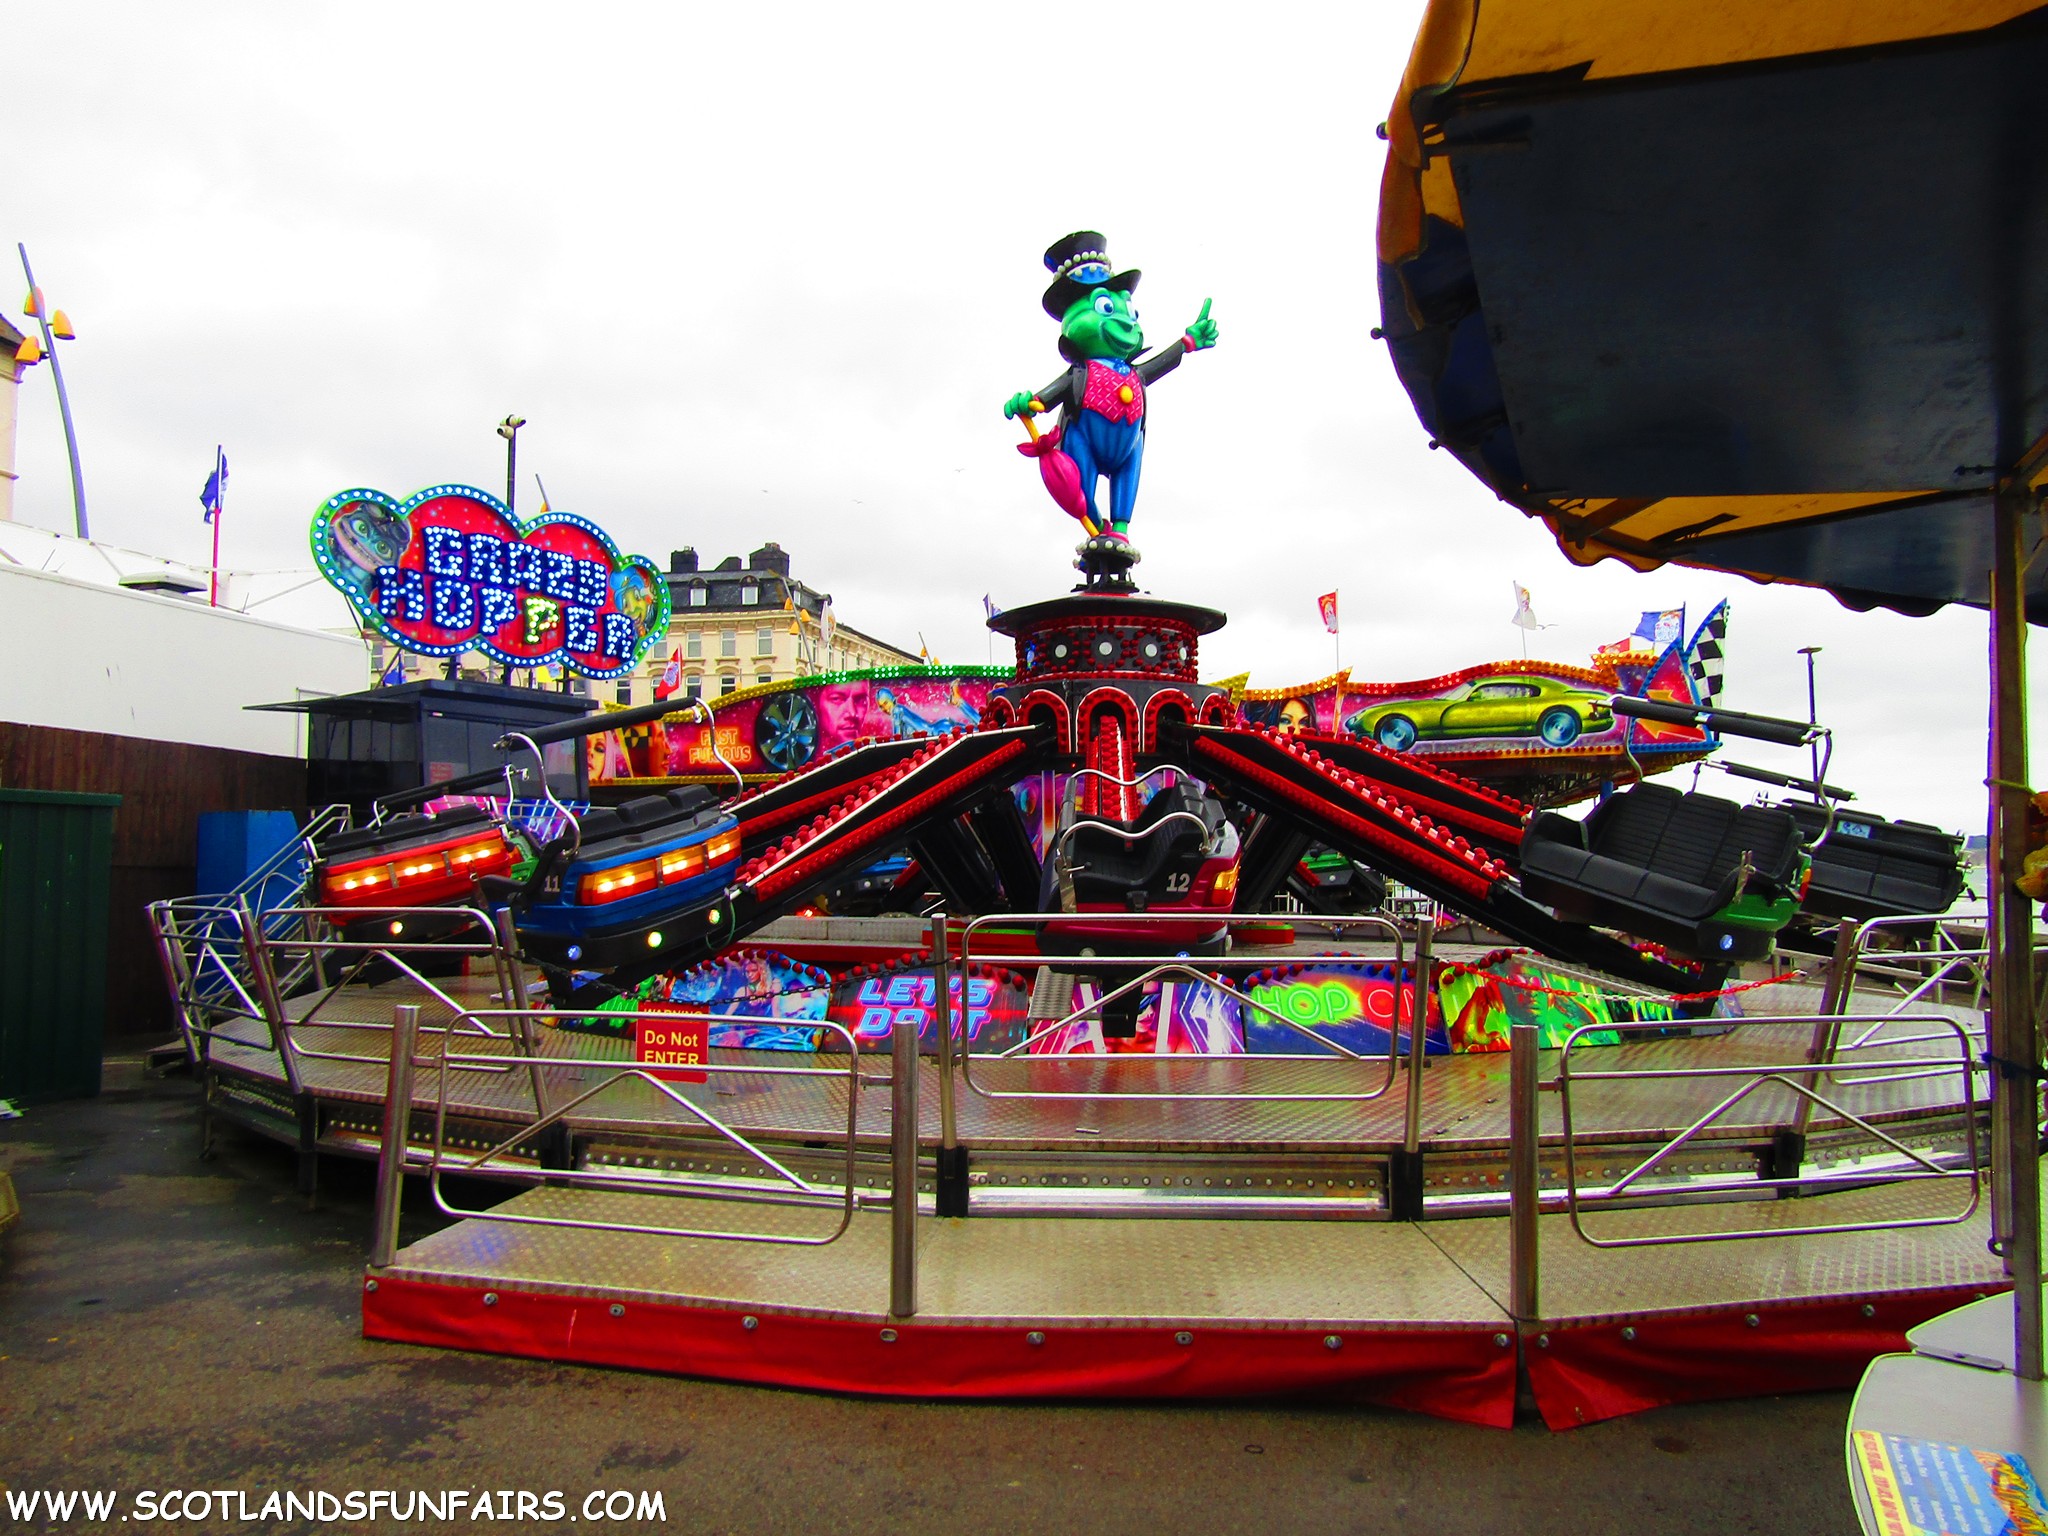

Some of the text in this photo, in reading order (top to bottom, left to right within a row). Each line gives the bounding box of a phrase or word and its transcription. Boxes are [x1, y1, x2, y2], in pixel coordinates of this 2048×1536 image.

[376, 565, 637, 662] HOPPER
[700, 728, 738, 746] FAST
[544, 875, 560, 892] 11
[1166, 873, 1190, 892] 12
[858, 976, 996, 1006] LET'S
[1255, 986, 1350, 1025] HOP
[860, 1007, 930, 1037] DO
[644, 1029, 699, 1047] Do Not
[644, 1050, 699, 1065] ENTER
